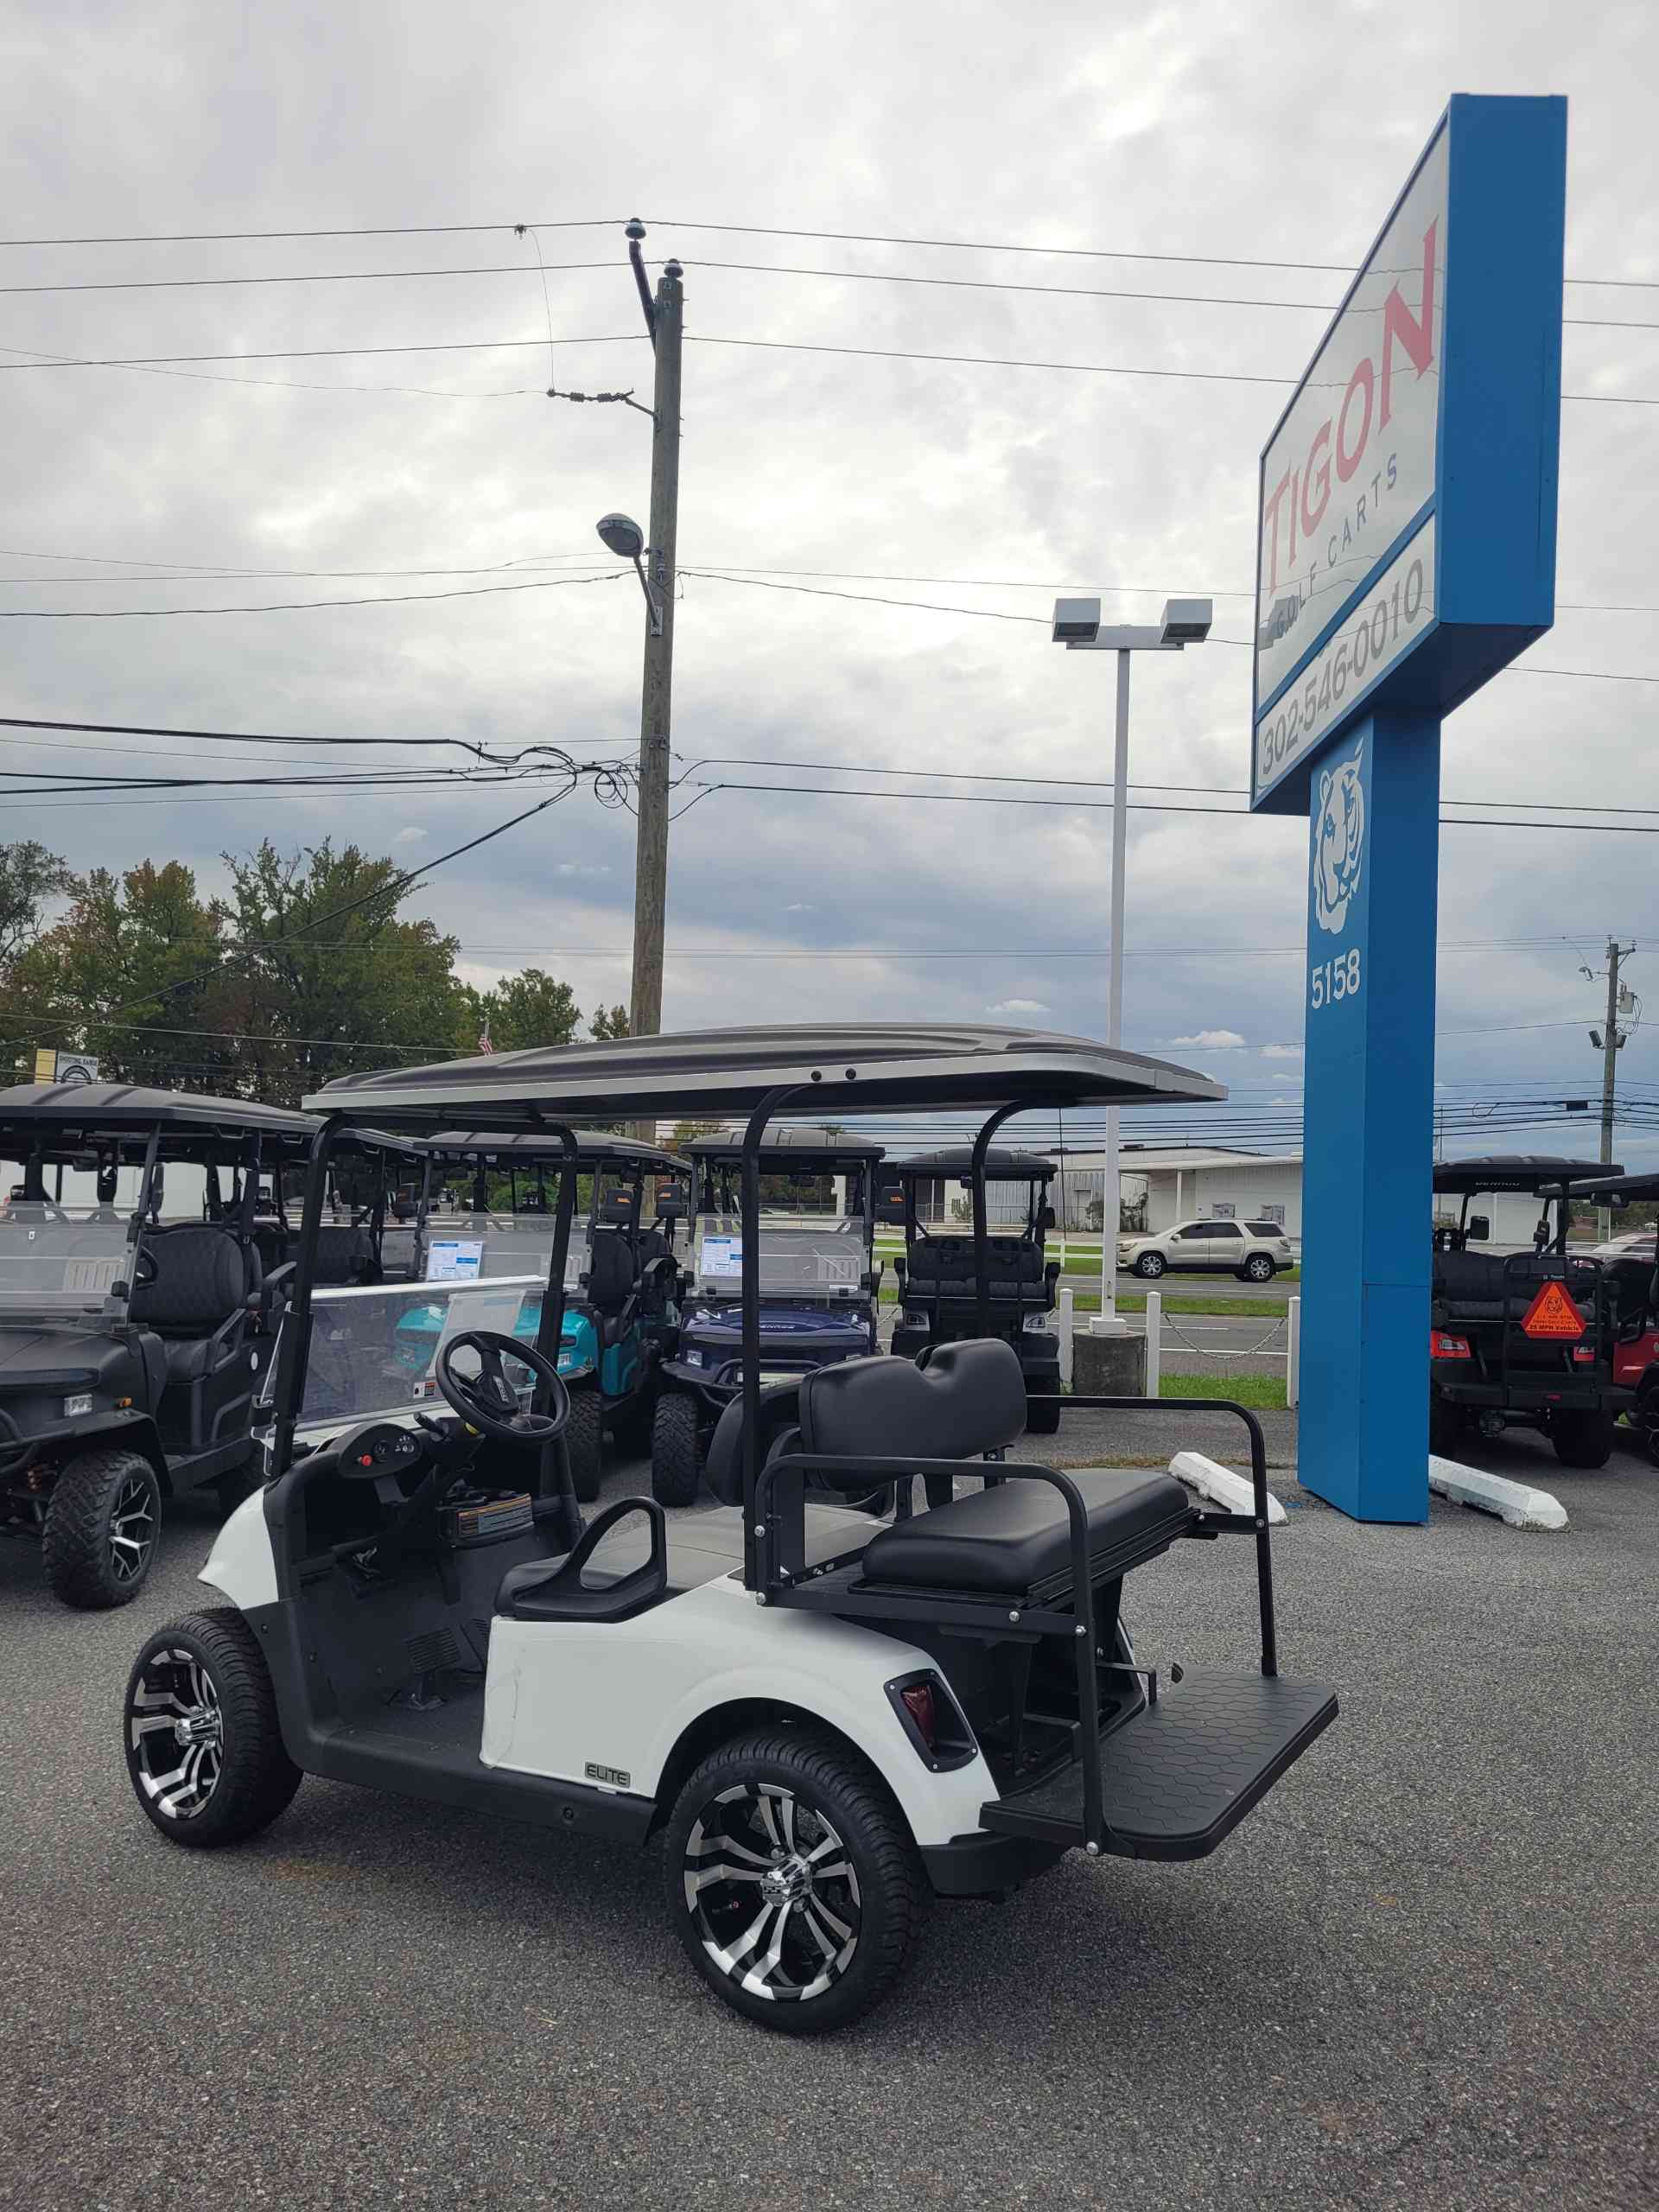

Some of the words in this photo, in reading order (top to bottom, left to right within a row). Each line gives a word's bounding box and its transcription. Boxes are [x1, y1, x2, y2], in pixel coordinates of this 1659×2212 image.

[1264, 214, 1439, 600] TIGON
[1277, 560, 1317, 636] GOLF
[1328, 453, 1396, 568] CARTS
[1312, 948, 1361, 1009] 5158
[587, 1764, 629, 1786] ELITE
